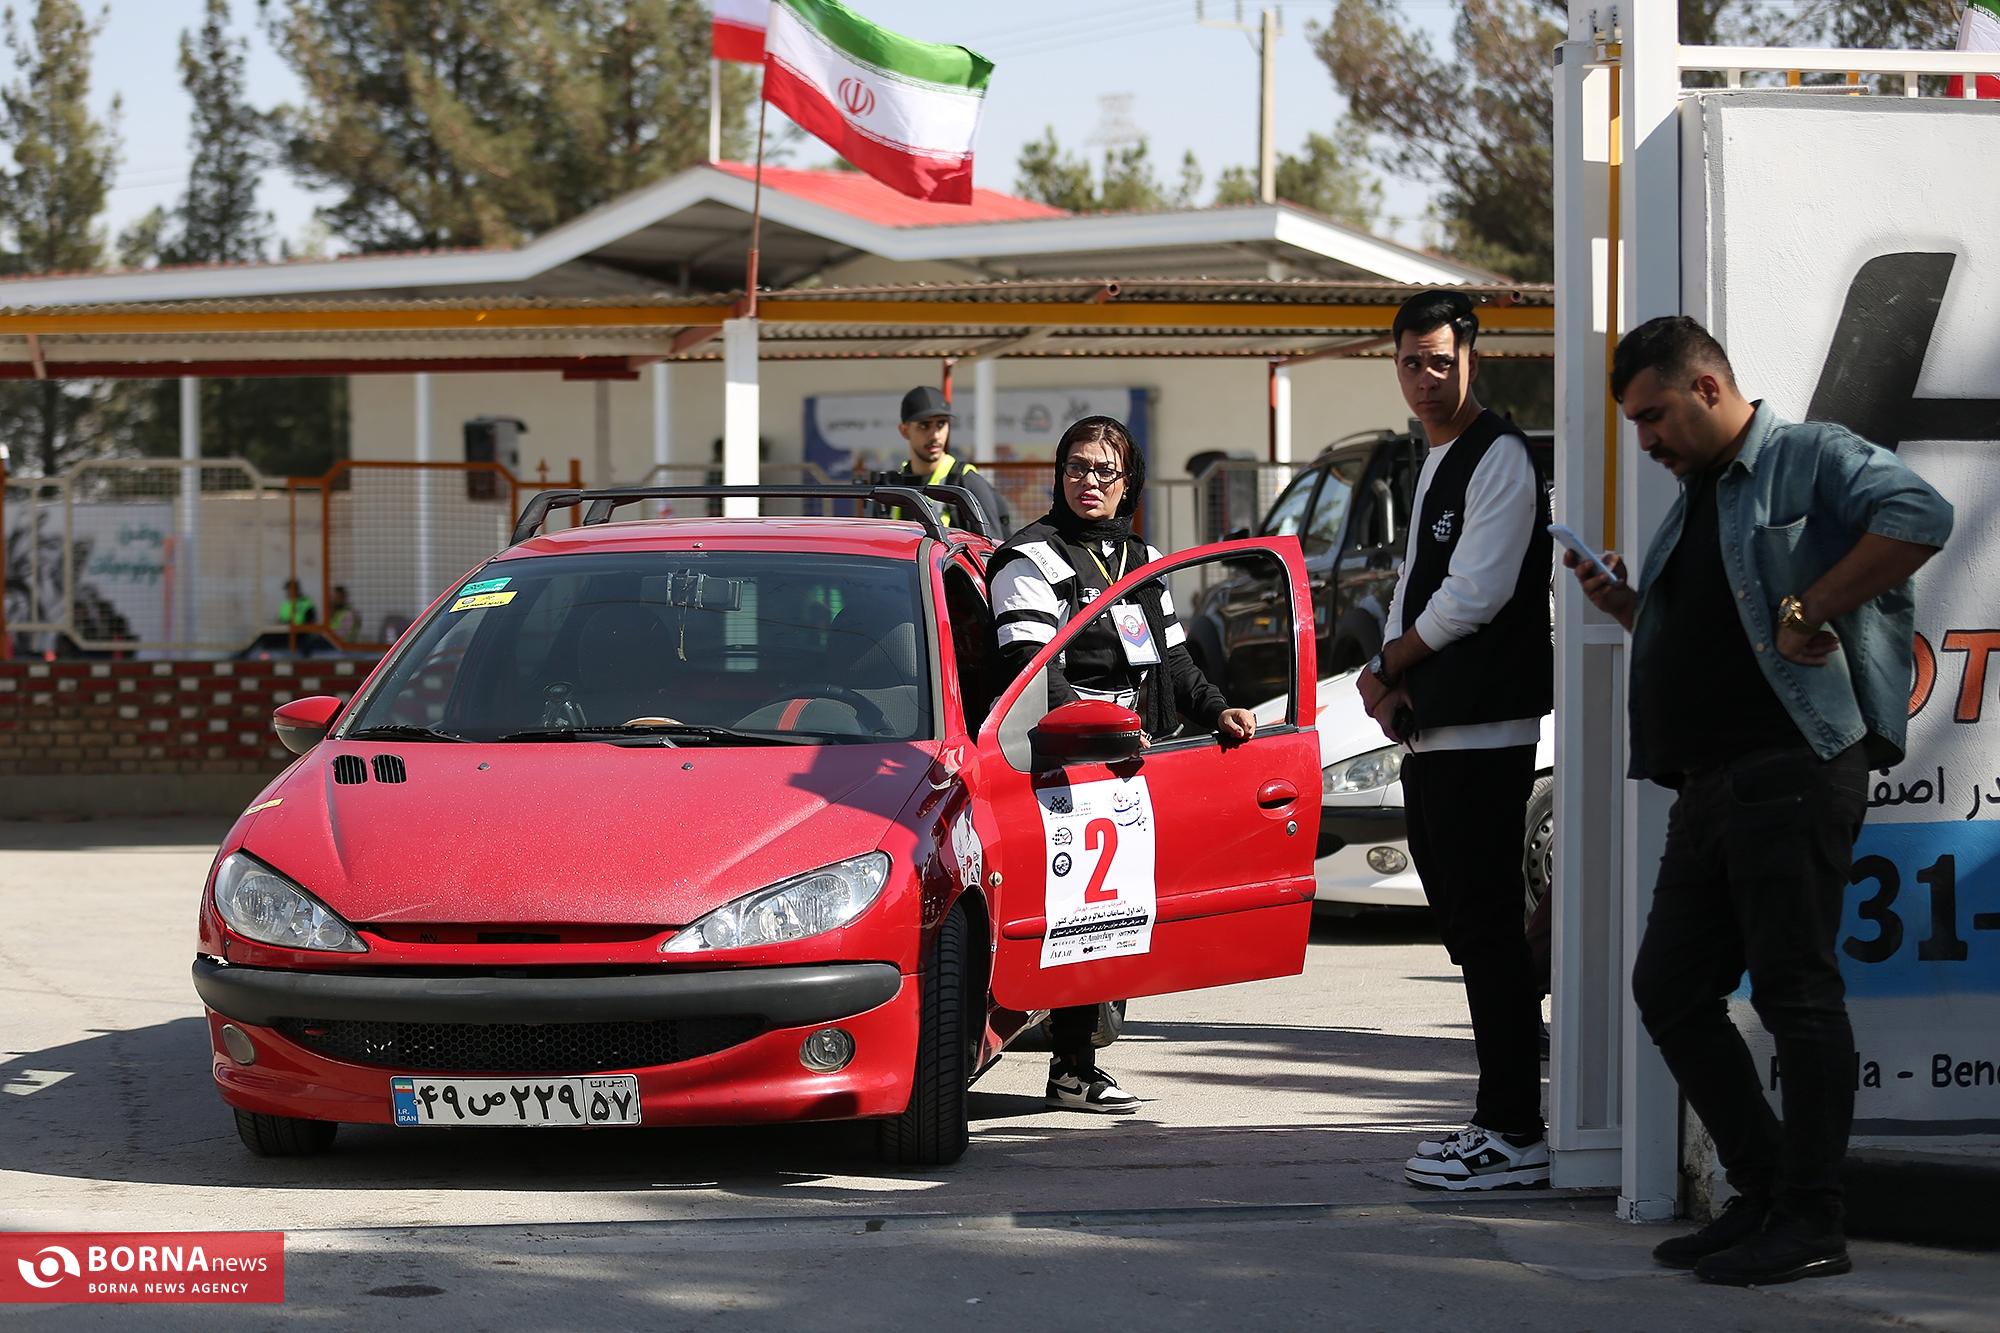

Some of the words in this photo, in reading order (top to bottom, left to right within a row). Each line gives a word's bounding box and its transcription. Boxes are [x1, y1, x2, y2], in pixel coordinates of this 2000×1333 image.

[1084, 817, 1119, 904] 2
[1931, 1053, 2000, 1088] Ben
[398, 1114, 417, 1123] IRAN
